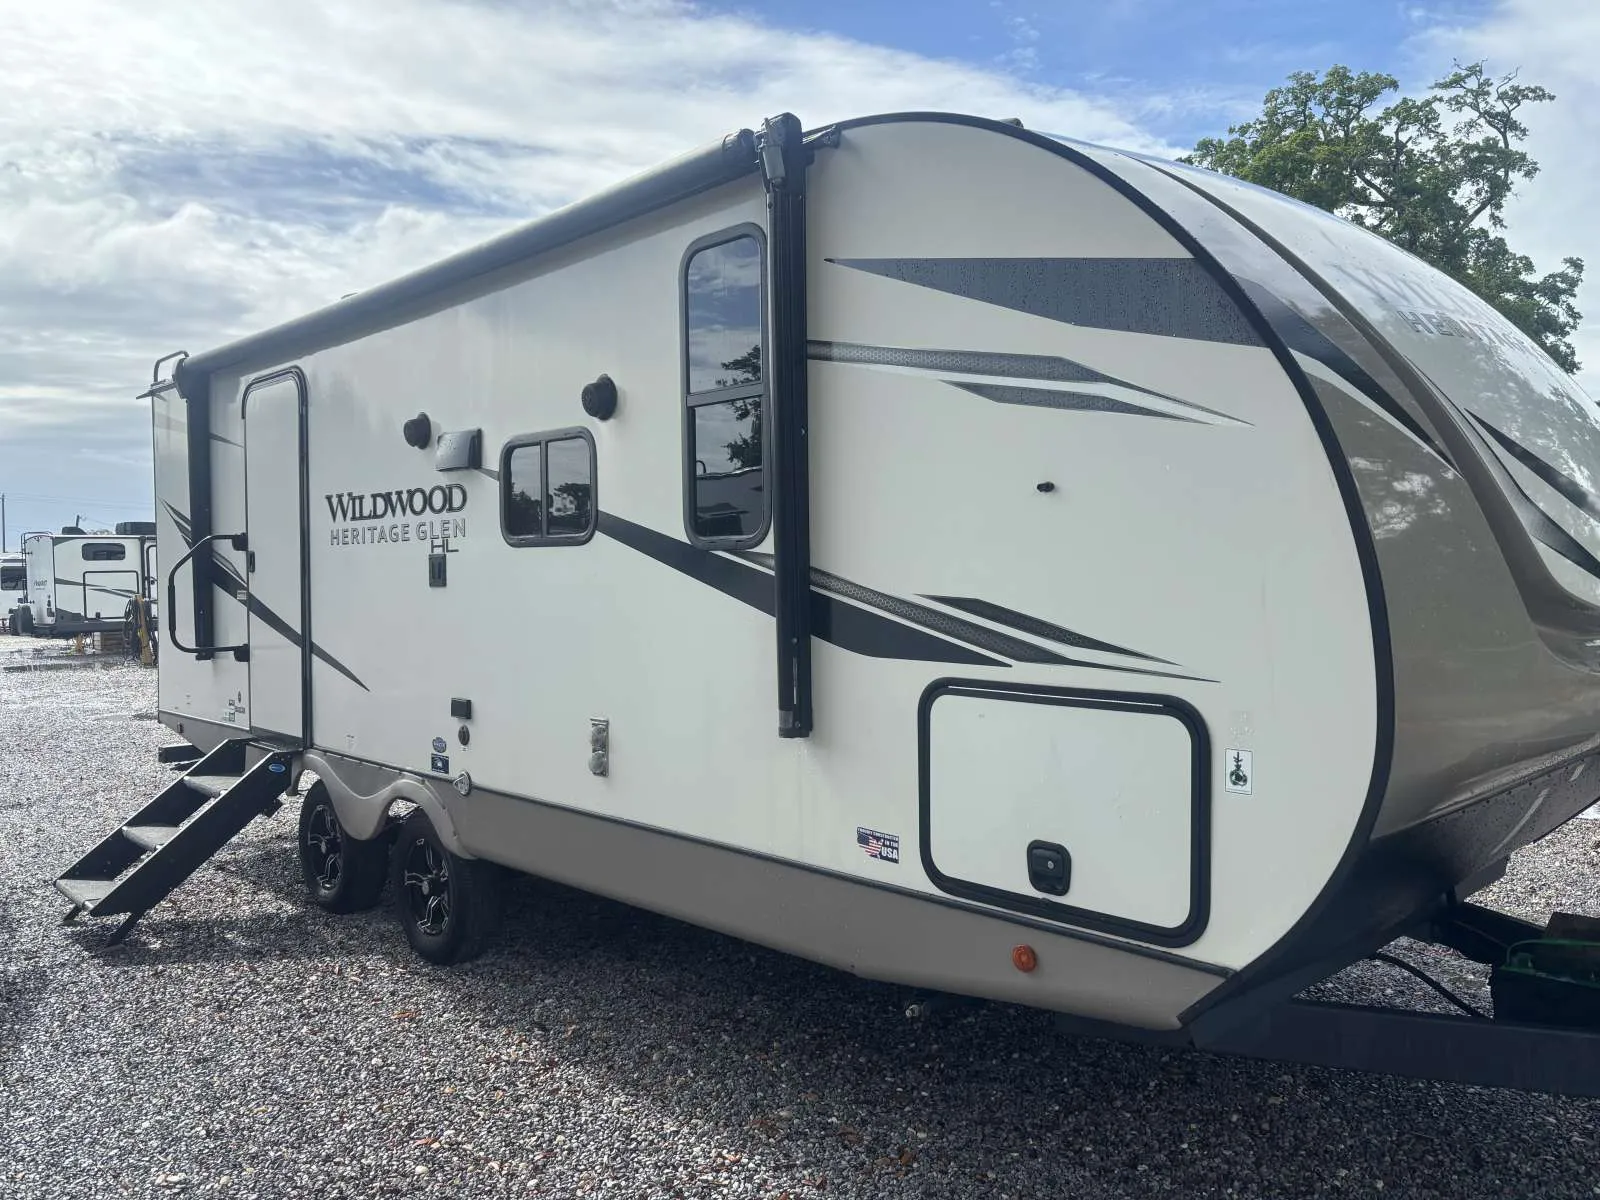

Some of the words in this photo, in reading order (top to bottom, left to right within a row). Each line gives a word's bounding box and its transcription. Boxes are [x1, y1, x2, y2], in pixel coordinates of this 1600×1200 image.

[325, 483, 467, 522] WILDWOOD
[330, 523, 410, 546] HERITAGE
[416, 518, 466, 539] GLEN
[431, 538, 459, 553] HL
[881, 846, 898, 859] USA
